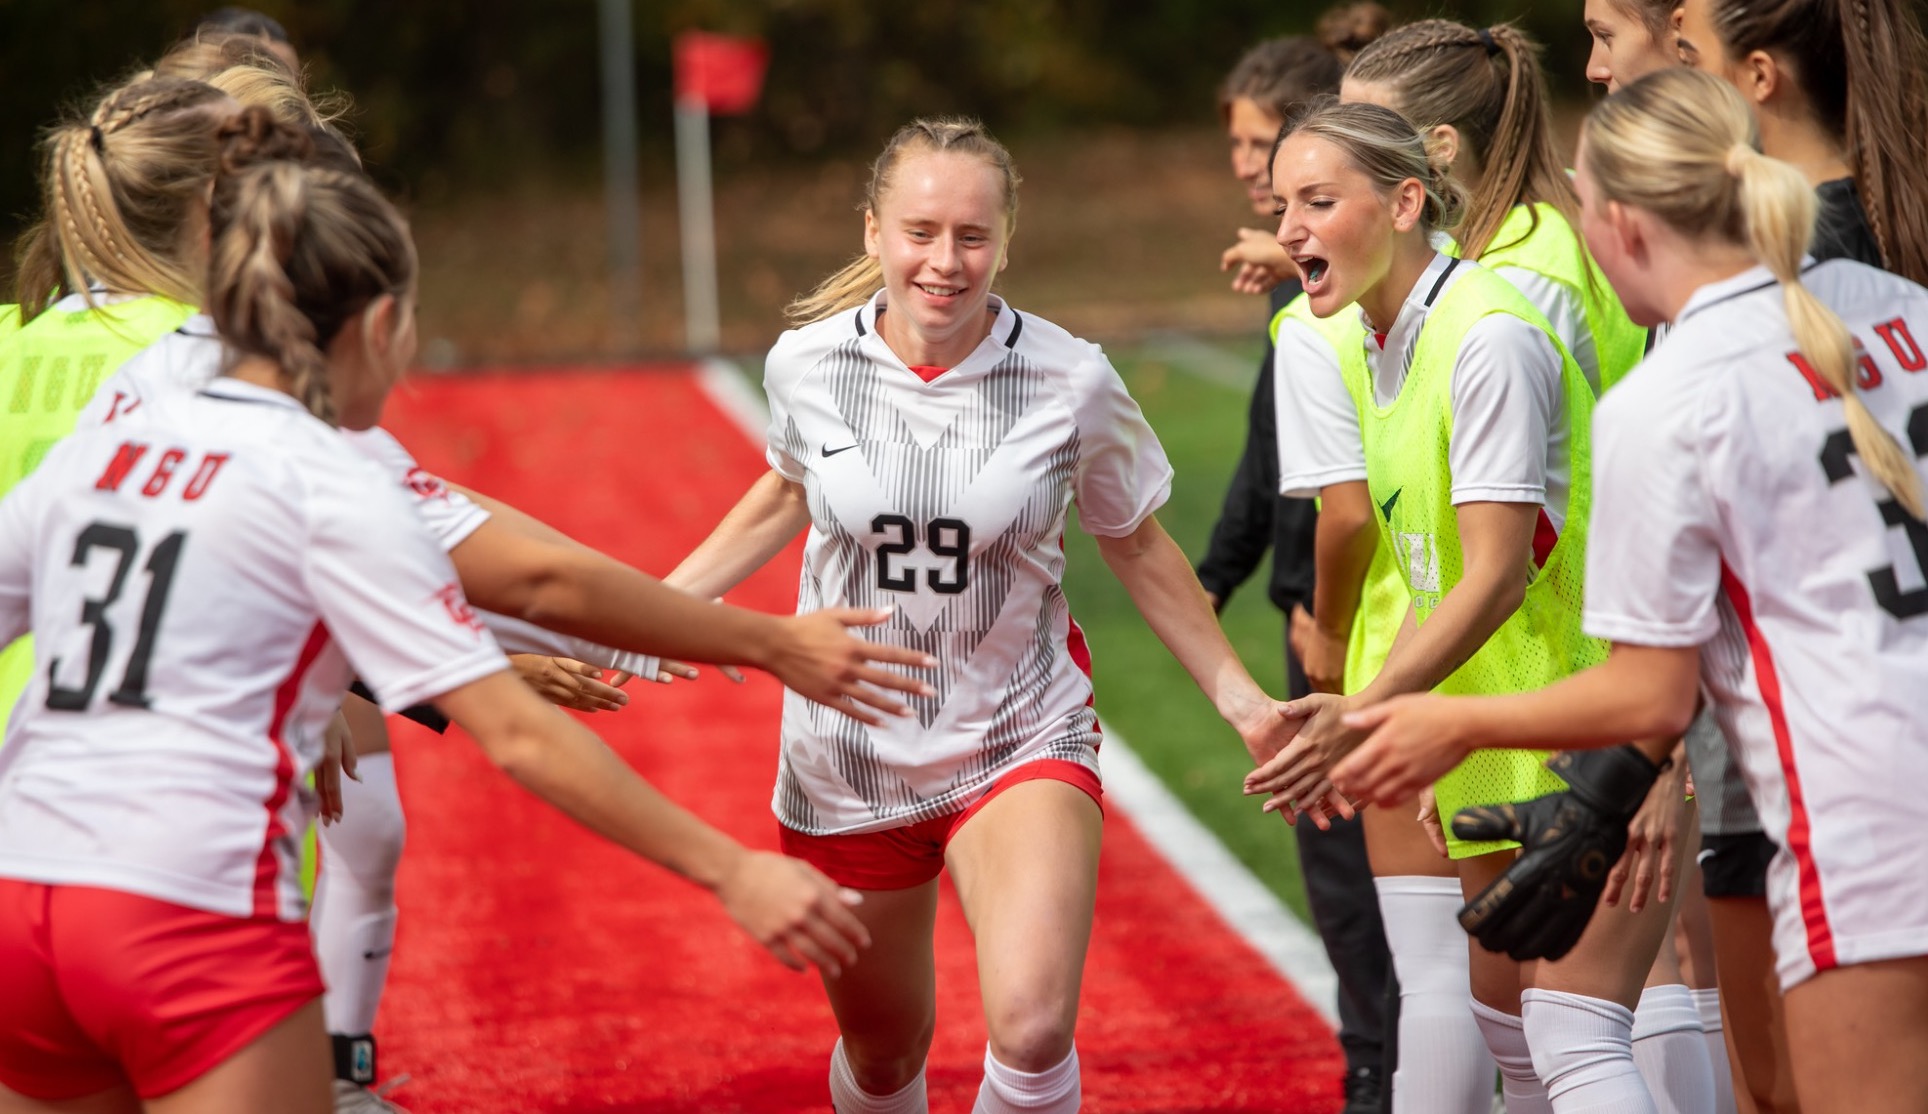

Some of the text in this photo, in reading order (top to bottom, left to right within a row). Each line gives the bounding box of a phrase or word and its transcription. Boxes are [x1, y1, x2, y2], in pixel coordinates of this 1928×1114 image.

[95, 441, 232, 502] NGU
[869, 511, 973, 596] 29
[45, 521, 191, 713] 31
